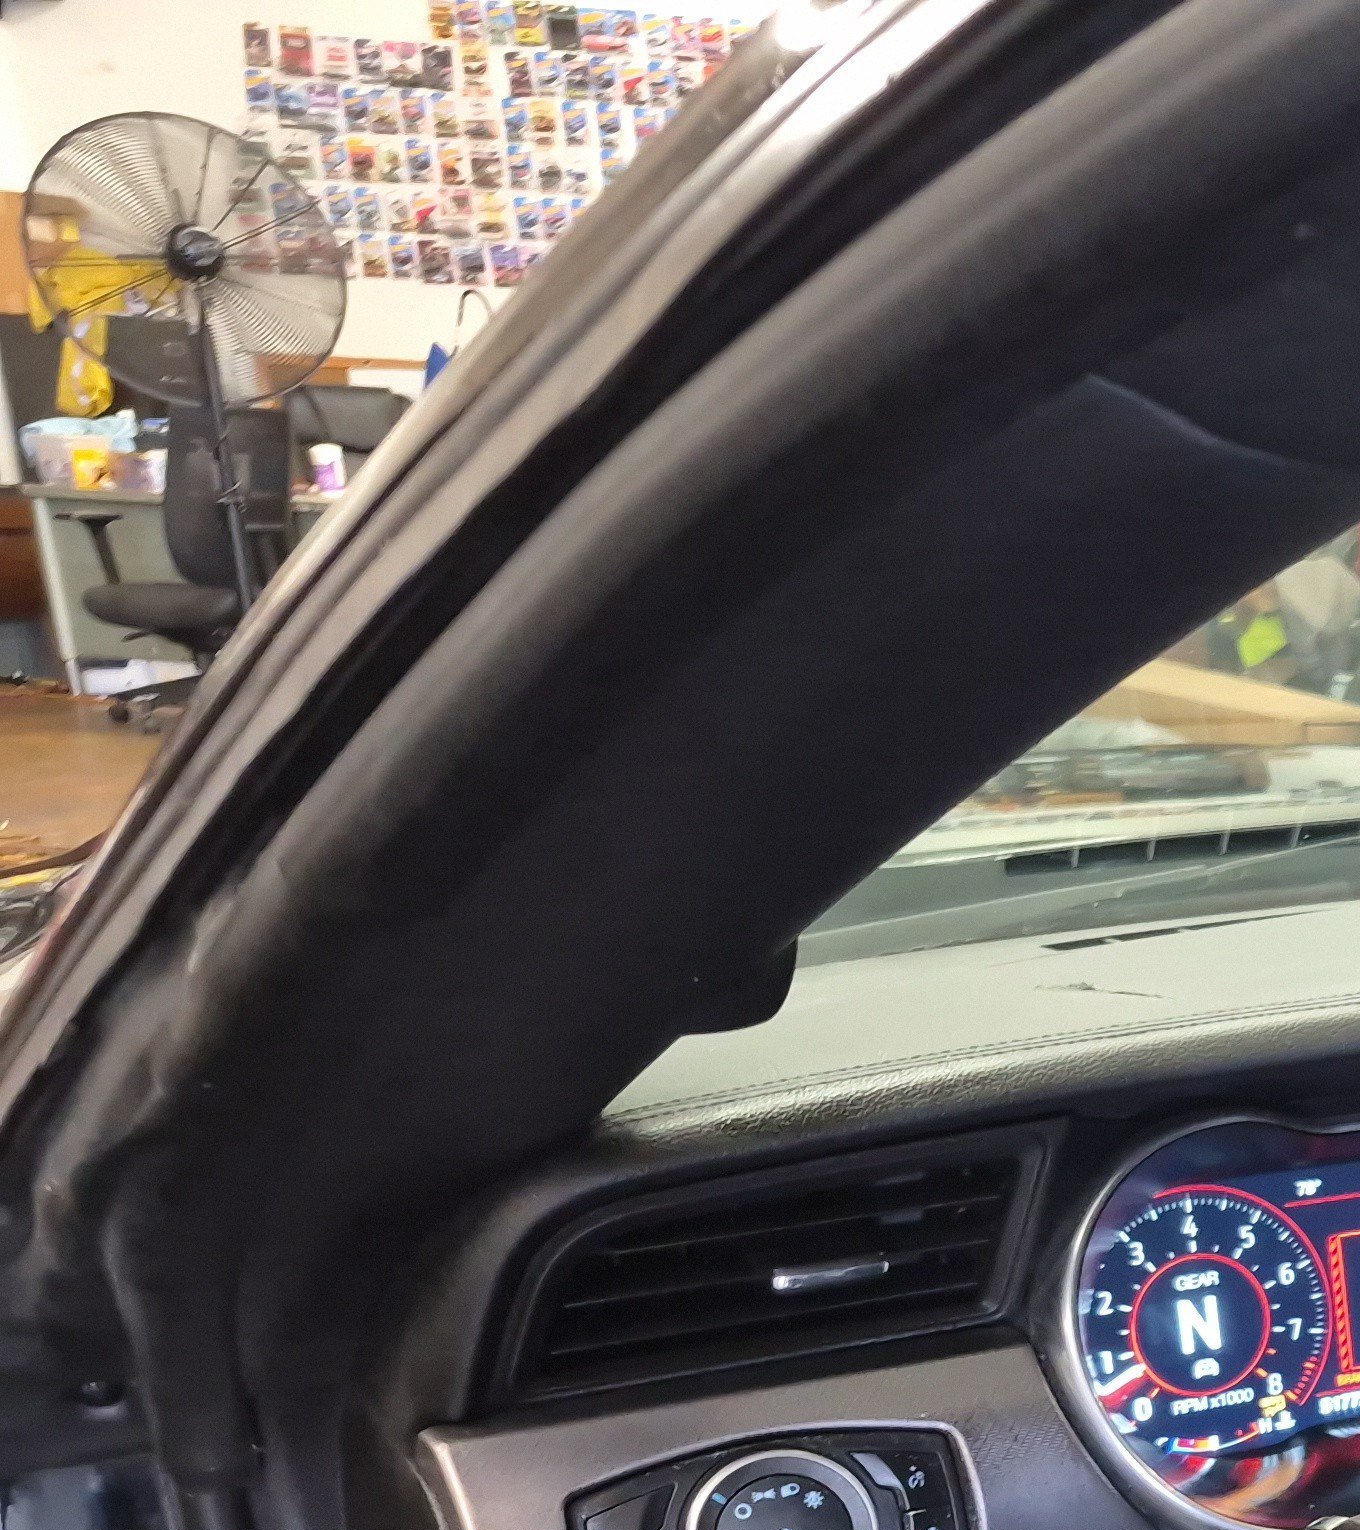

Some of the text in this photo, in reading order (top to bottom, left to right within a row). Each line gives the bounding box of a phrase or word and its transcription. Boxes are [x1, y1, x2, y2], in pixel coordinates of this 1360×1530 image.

[1180, 1215, 1199, 1238] 4
[1238, 1225, 1256, 1249] 5
[1128, 1242, 1146, 1267] 3
[1172, 1270, 1220, 1292] GEAR
[1278, 1262, 1296, 1286] 6
[1094, 1290, 1114, 1316] 2
[1175, 1294, 1223, 1356] N
[1286, 1317, 1303, 1341] 7
[1098, 1350, 1115, 1375] 1
[1266, 1372, 1284, 1395] 8
[1131, 1396, 1153, 1422] 0
[1170, 1387, 1255, 1417] RPM x1000
